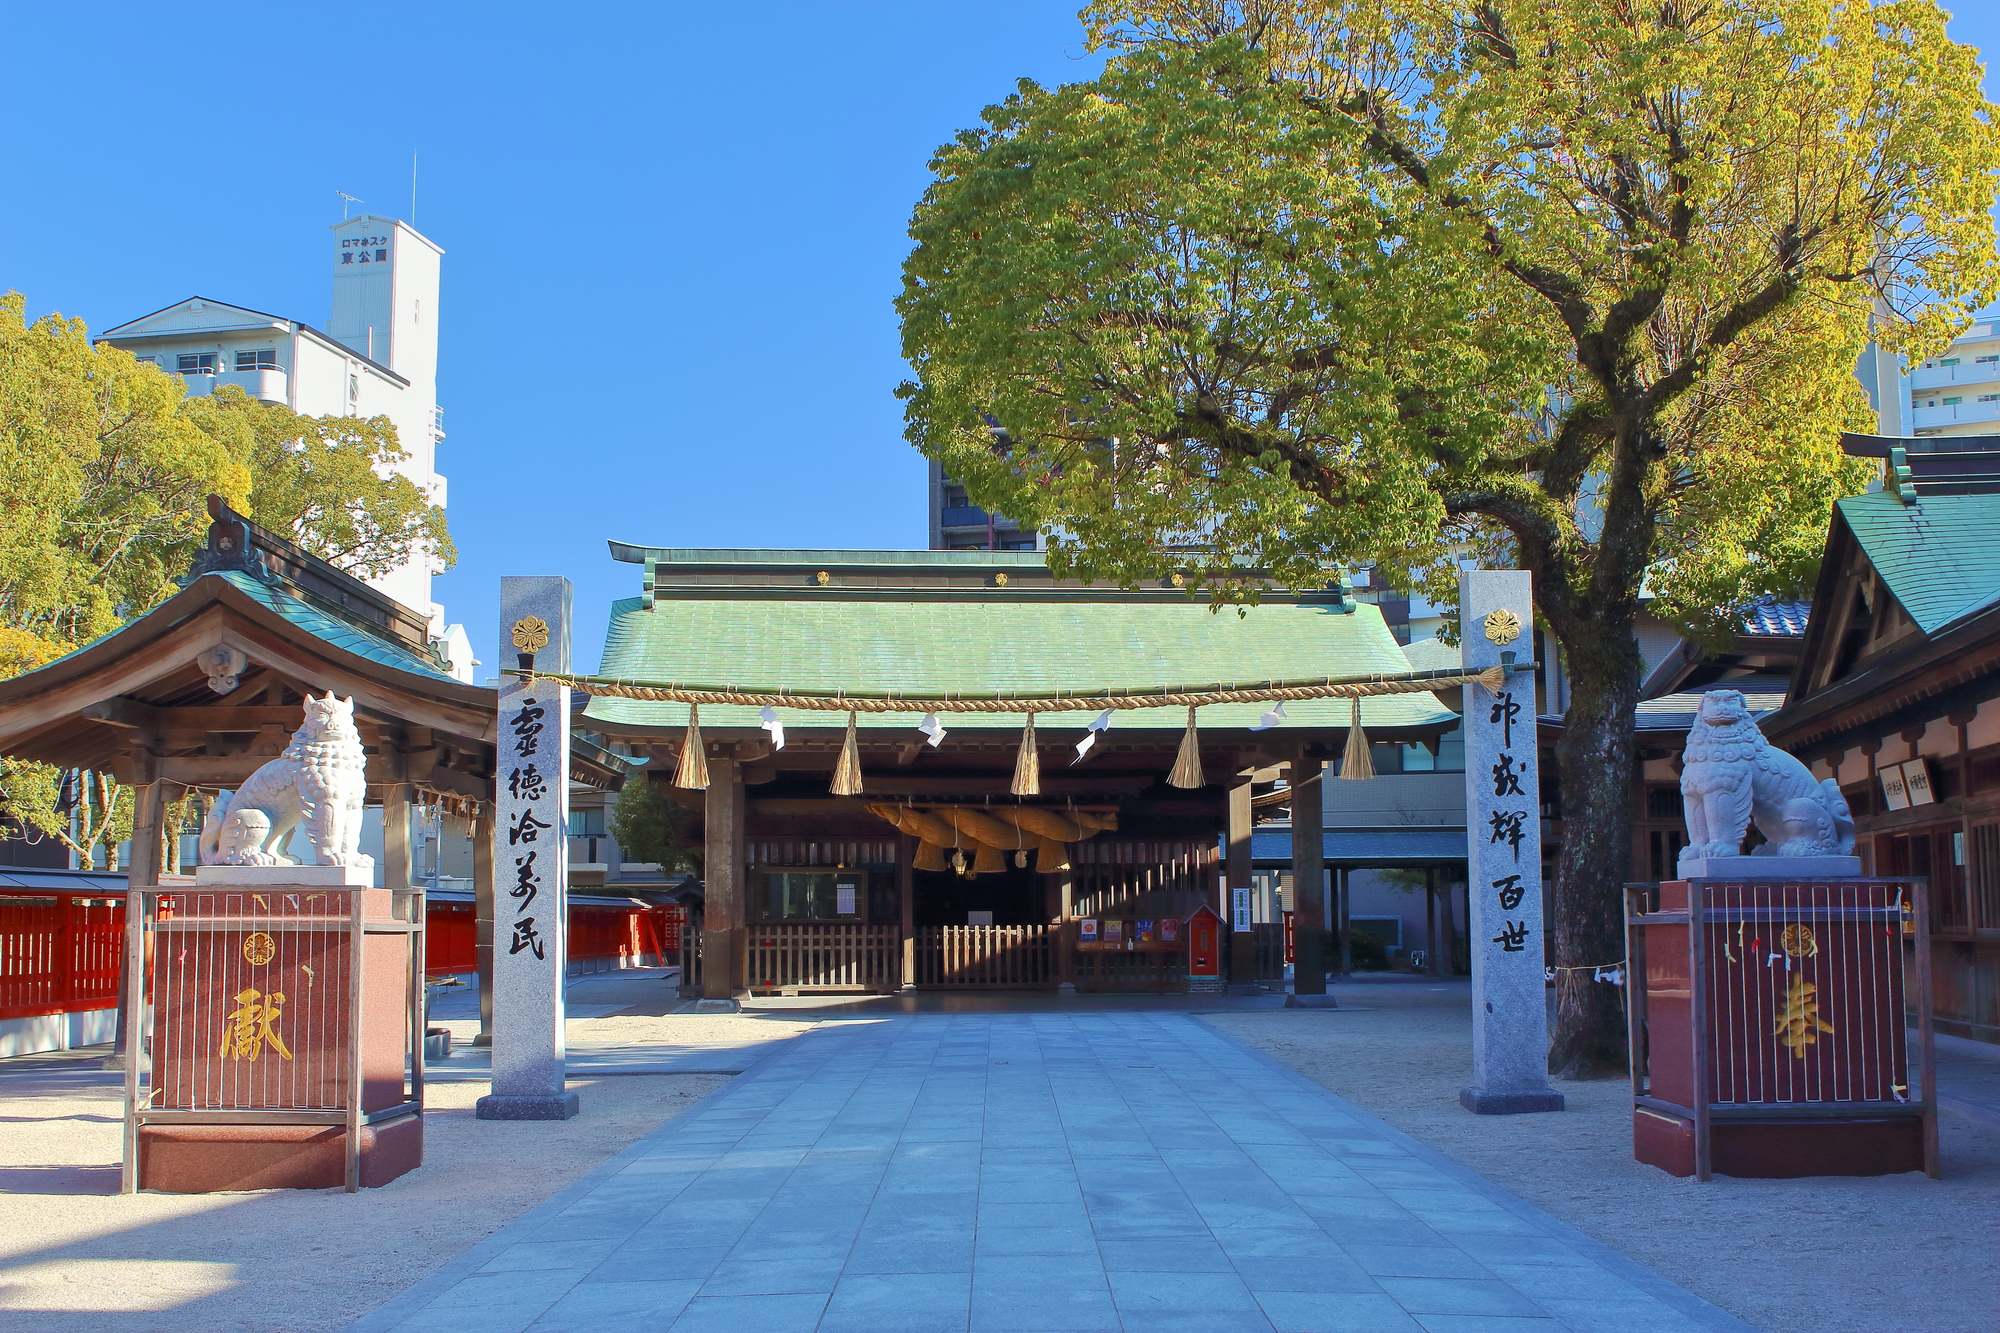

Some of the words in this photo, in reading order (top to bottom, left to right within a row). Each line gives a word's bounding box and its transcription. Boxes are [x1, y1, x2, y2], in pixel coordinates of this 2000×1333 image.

[342, 236, 388, 248] ロマネスク
[341, 249, 387, 264] 東公園
[1769, 971, 1834, 1059] 奉
